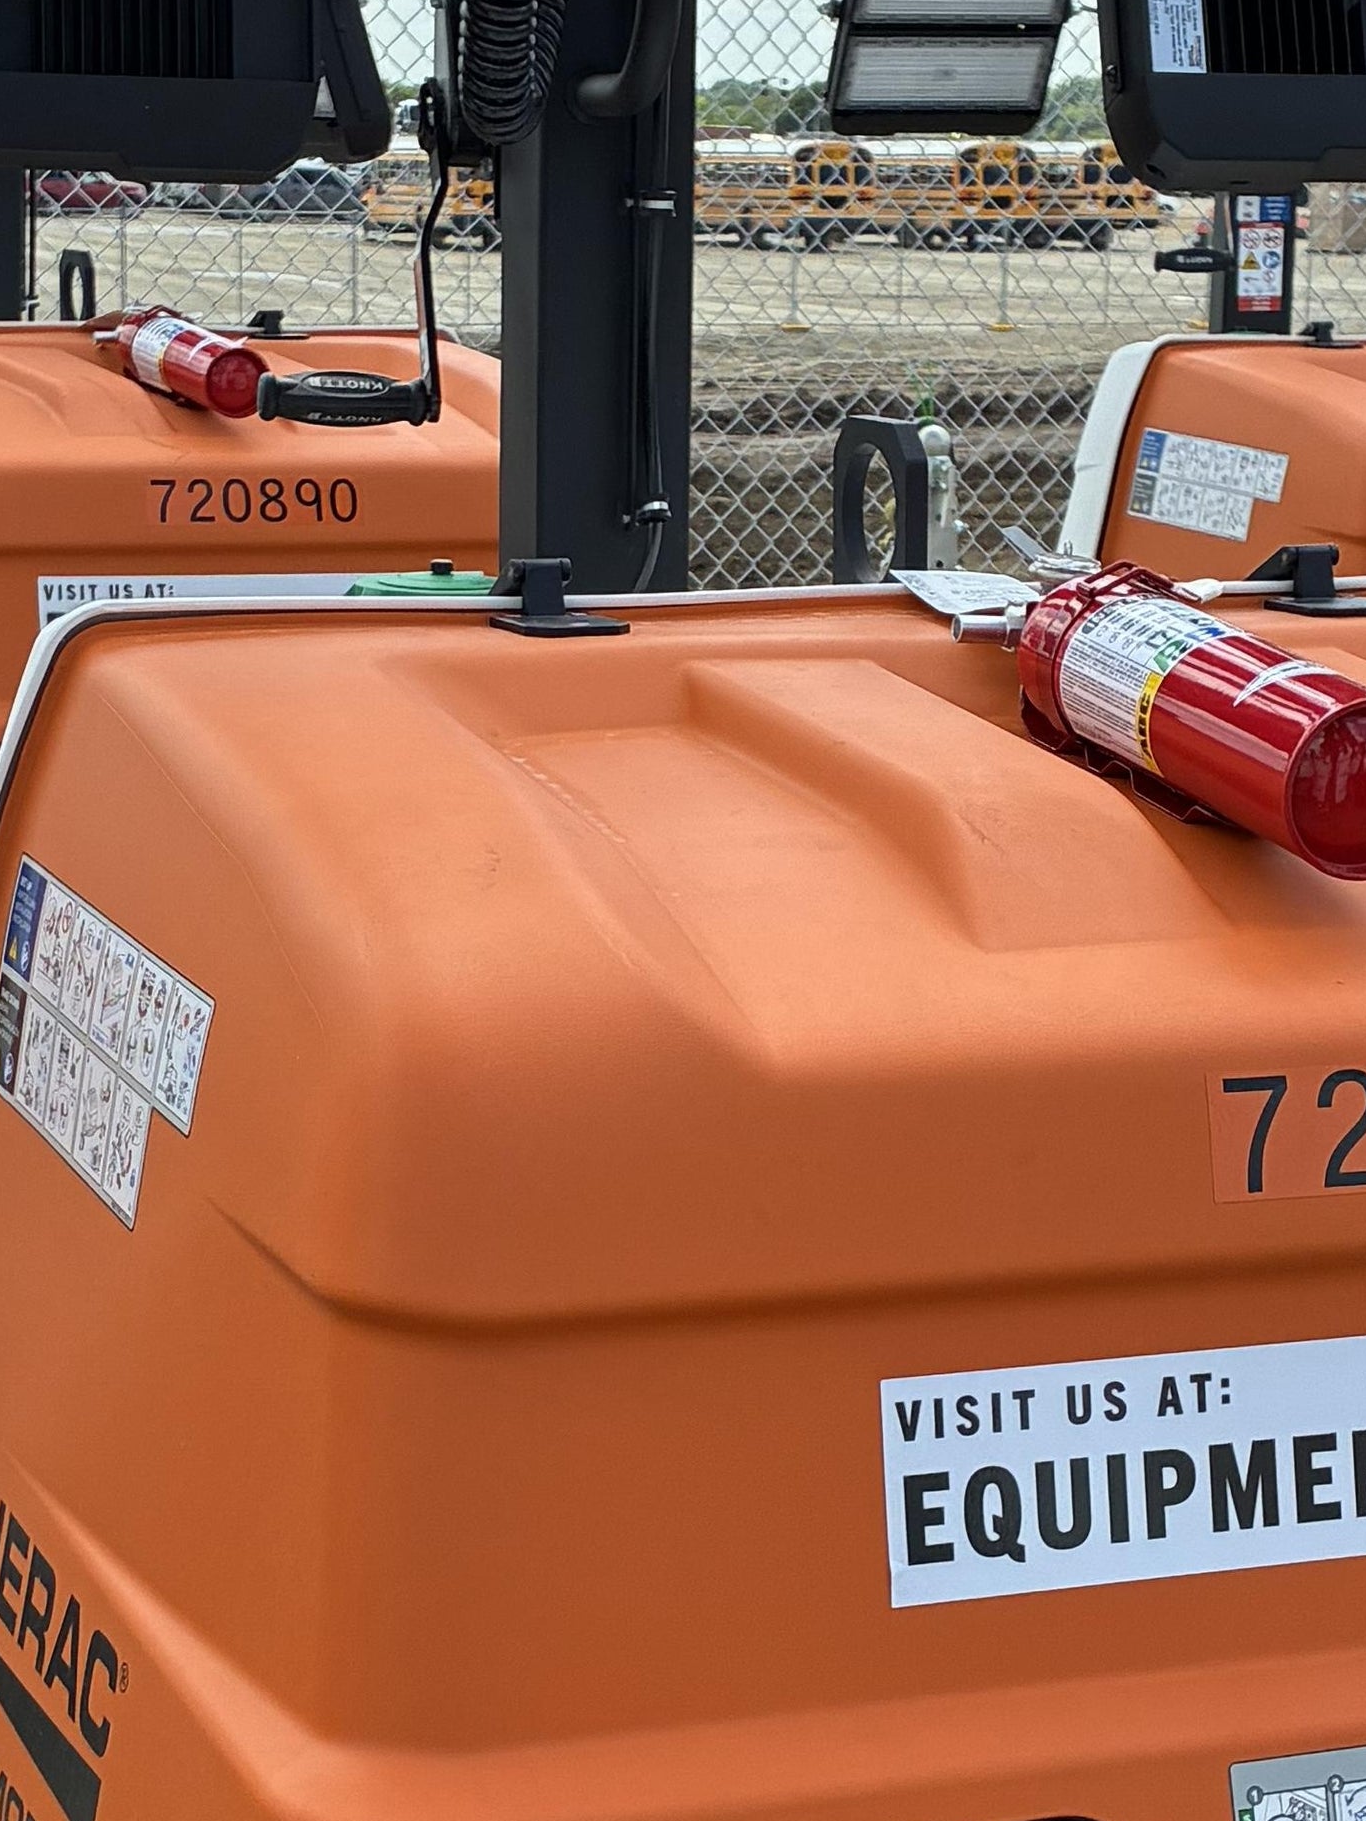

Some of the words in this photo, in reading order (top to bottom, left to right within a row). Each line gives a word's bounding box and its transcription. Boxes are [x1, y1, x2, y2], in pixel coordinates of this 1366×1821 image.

[150, 478, 357, 523] 720890
[43, 583, 98, 602] VISIT
[109, 583, 133, 599] US
[893, 1388, 1036, 1444] VISIT
[1065, 1378, 1129, 1425] US
[1157, 1370, 1235, 1418] AT:
